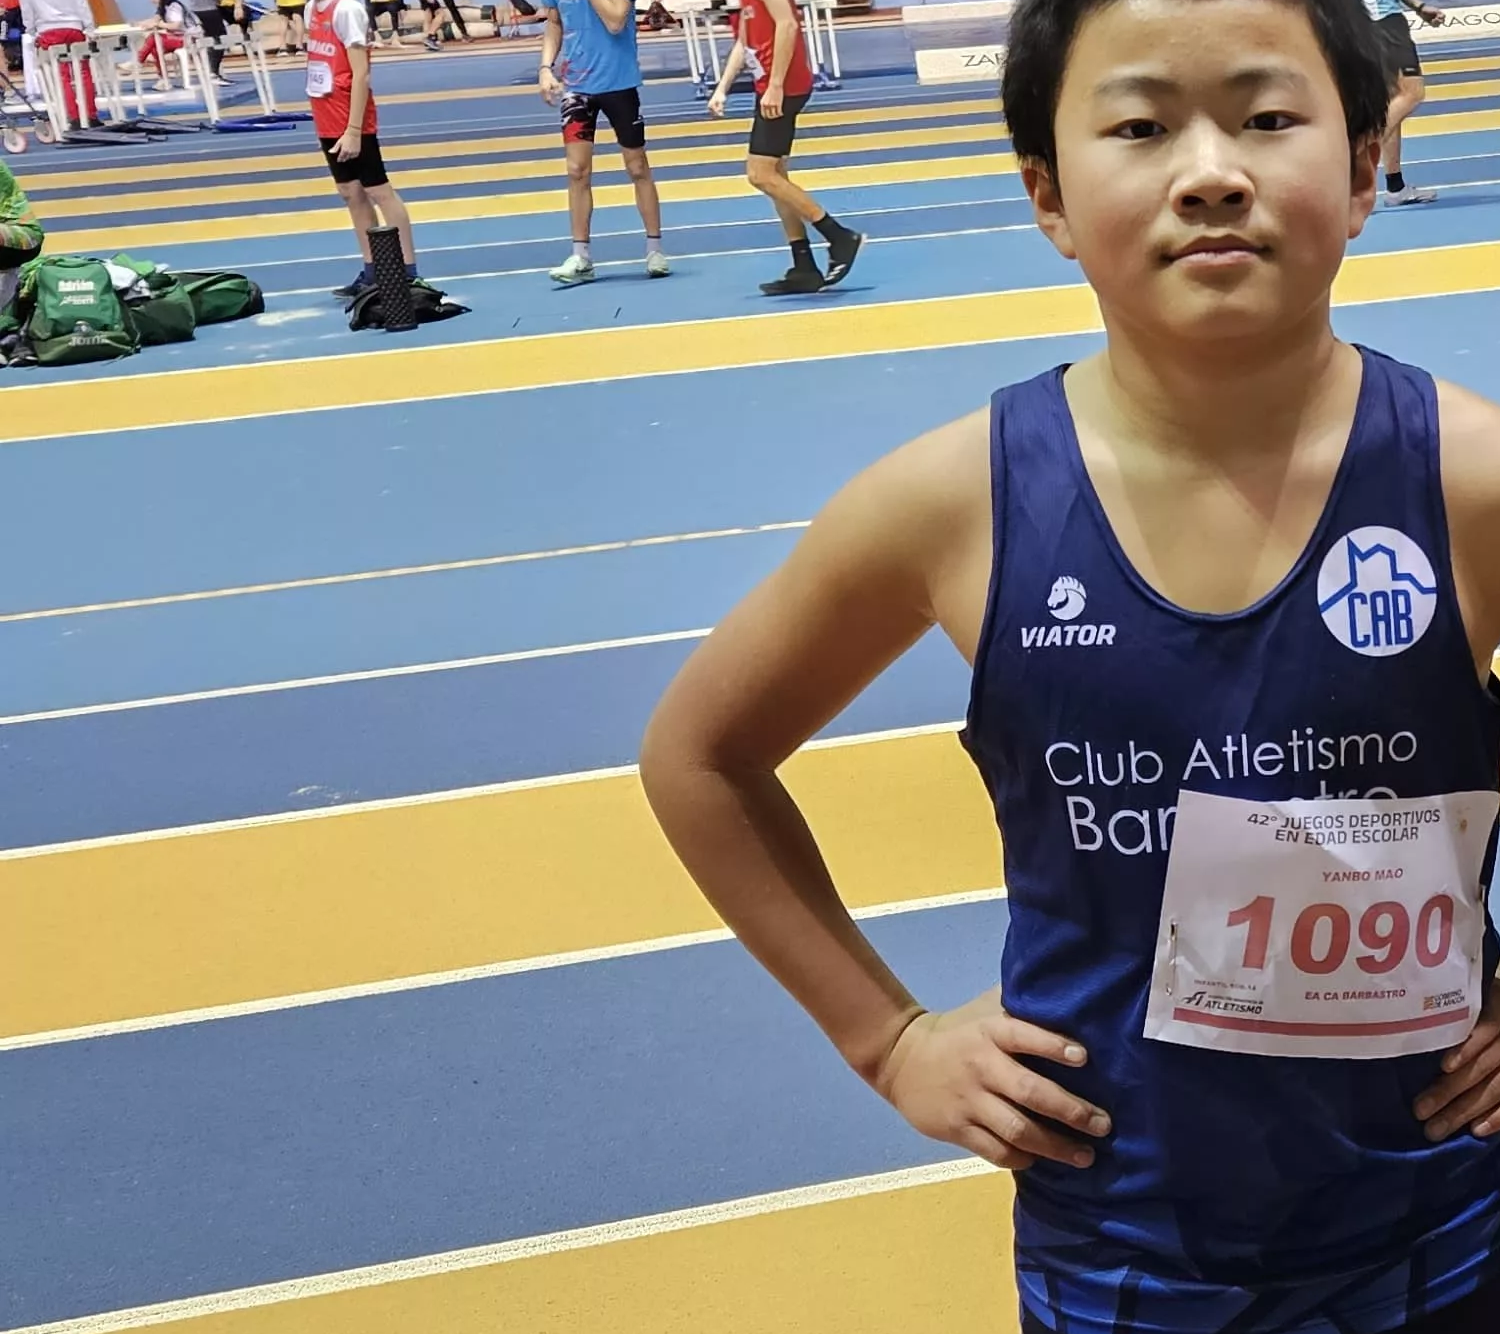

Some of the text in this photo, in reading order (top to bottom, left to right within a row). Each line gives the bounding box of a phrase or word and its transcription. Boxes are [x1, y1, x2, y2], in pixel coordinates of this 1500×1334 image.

[1347, 589, 1414, 648] CAB
[1020, 624, 1117, 648] VIATOR
[1045, 728, 1418, 787] Club Atletismo
[1281, 814, 1344, 830] JUEGOS
[1349, 809, 1441, 829] DEPORTIVOS
[1275, 827, 1419, 846] EN EDAD ESCOLAR
[1322, 868, 1403, 883] YANBO MAO
[1226, 894, 1454, 975] 1090
[1304, 989, 1406, 1001] EA CA BARBASTRO
[1205, 1000, 1264, 1015] ATLETISMO
